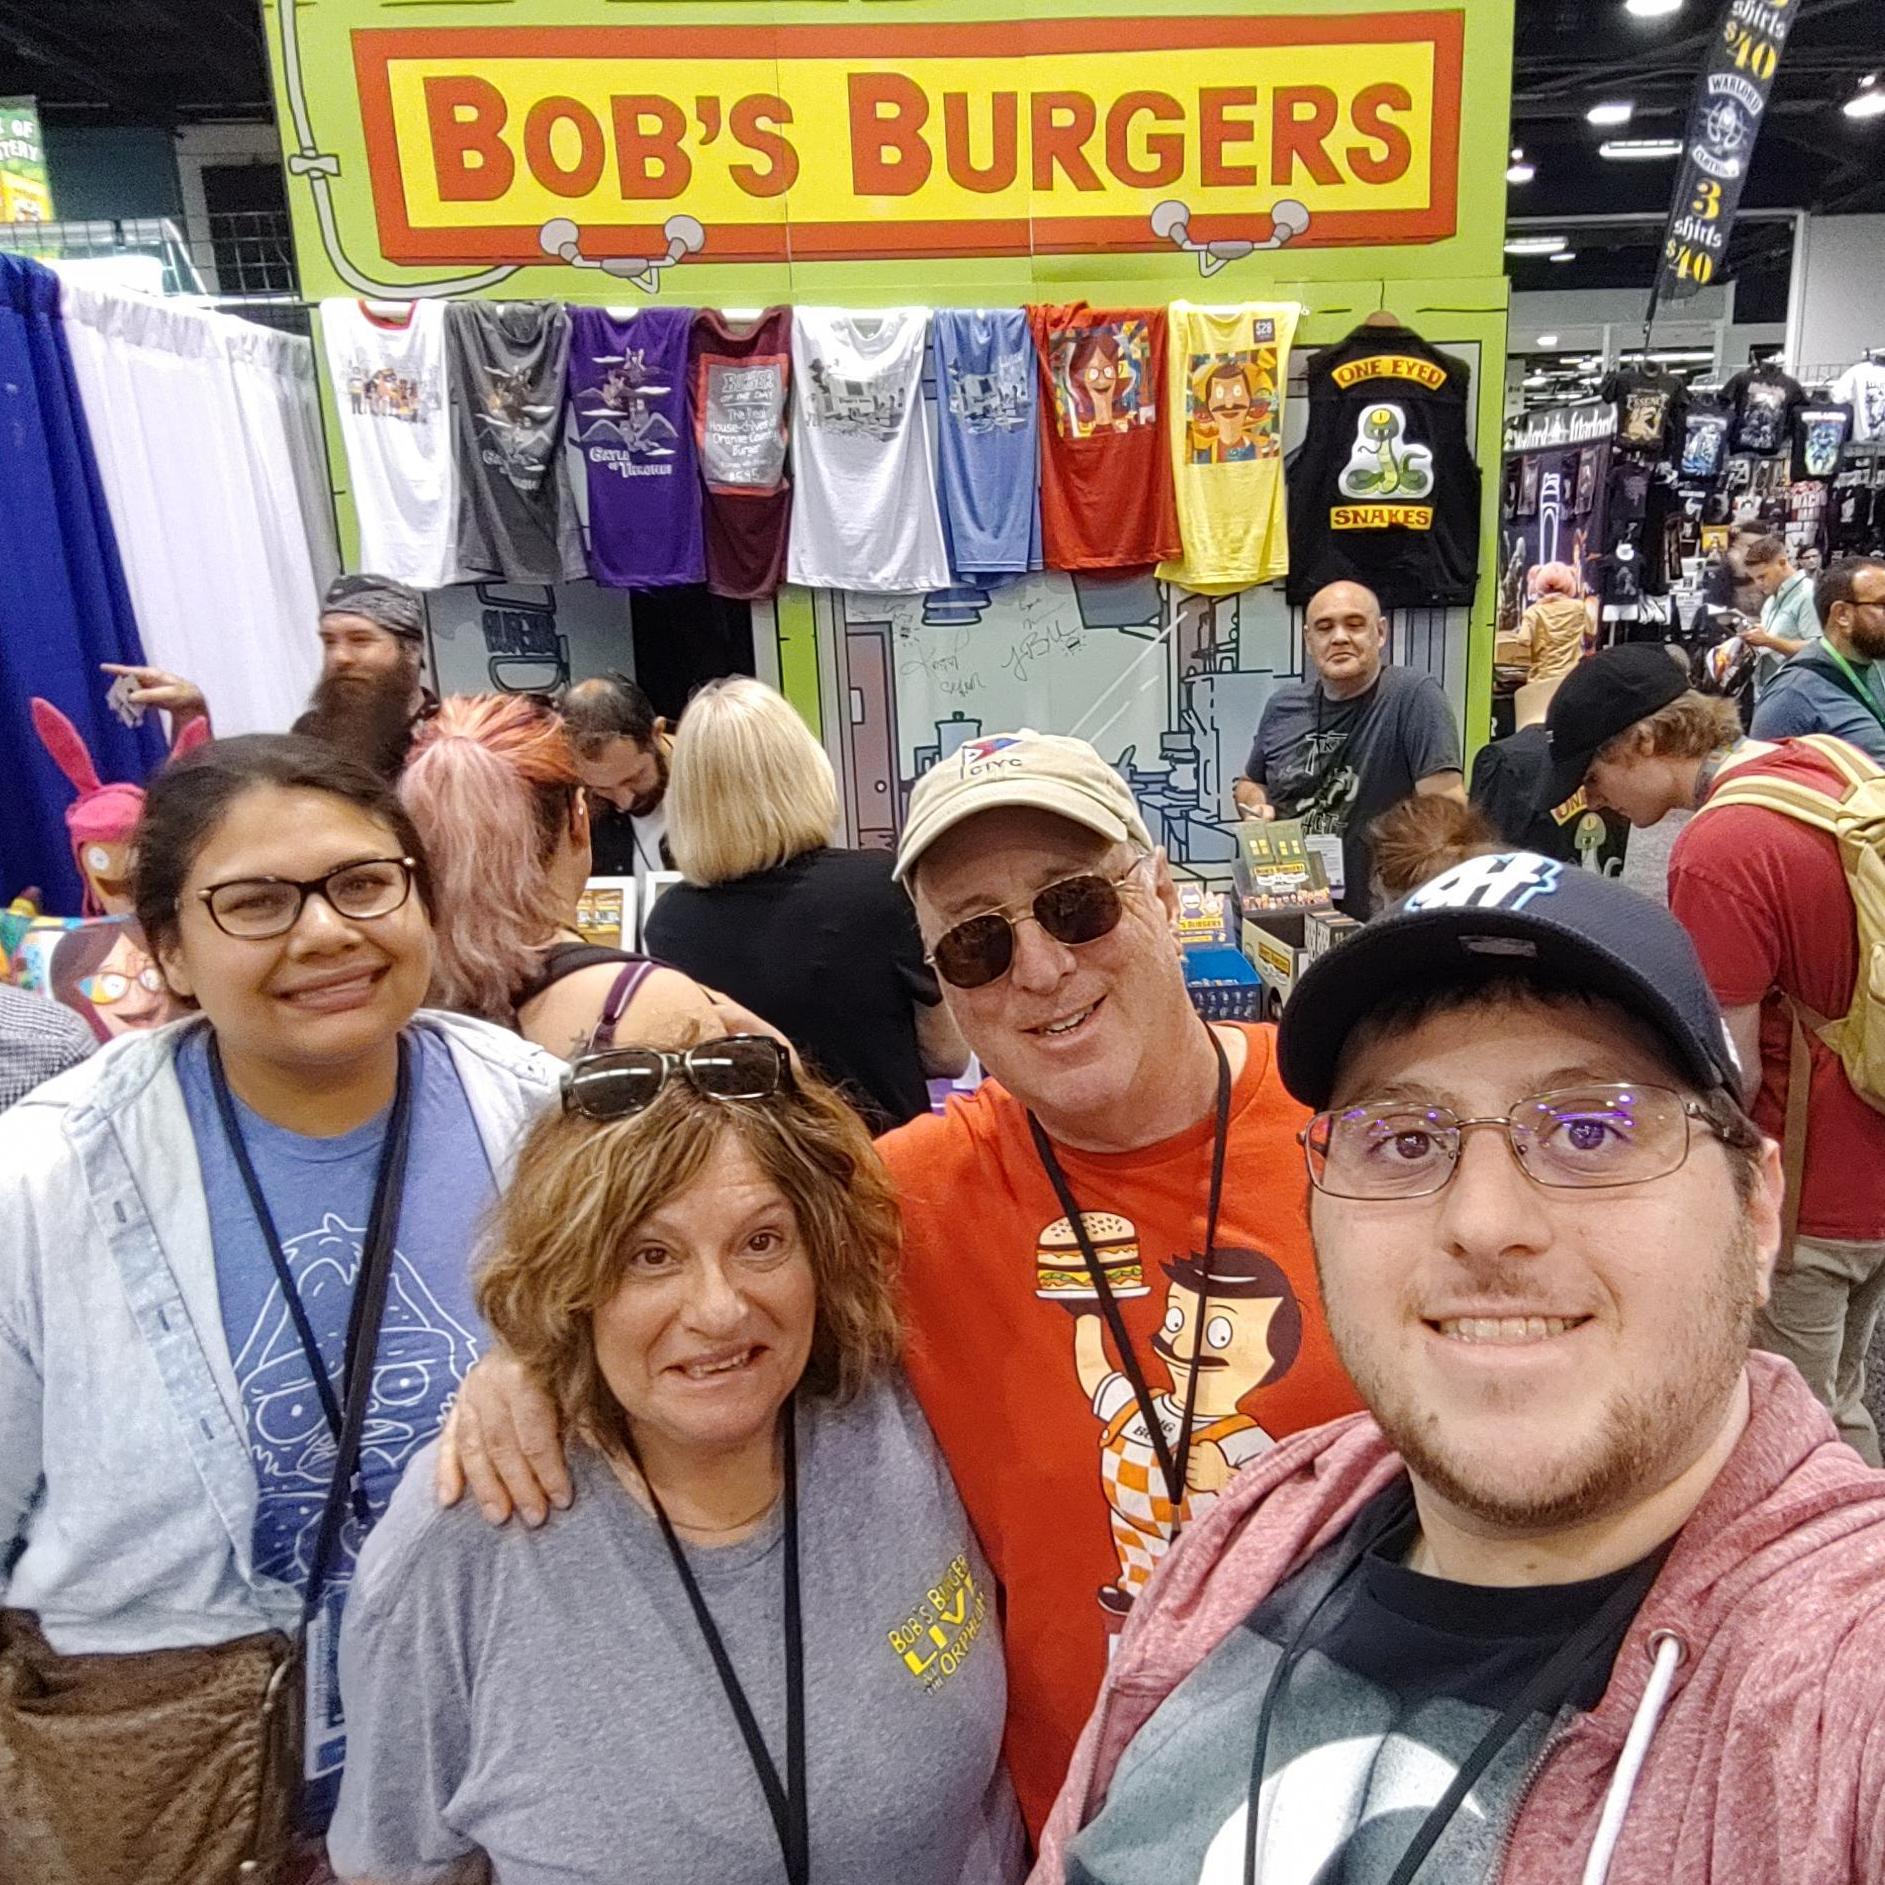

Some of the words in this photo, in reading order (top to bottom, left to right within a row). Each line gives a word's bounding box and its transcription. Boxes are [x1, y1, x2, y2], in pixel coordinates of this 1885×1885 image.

[1732, 0, 1786, 39] shirts
[1723, 20, 1777, 80] $40
[0, 139, 39, 161] TERY
[422, 75, 800, 202] BOB'S
[848, 72, 1413, 197] BURGERS
[1692, 178, 1722, 220] 3
[1673, 215, 1722, 248] shirts
[1665, 238, 1713, 284] $40
[1337, 359, 1383, 384] ONE
[1391, 359, 1442, 386] EYED
[1333, 509, 1430, 526] SNAKES
[888, 1604, 934, 1655] BOB'S
